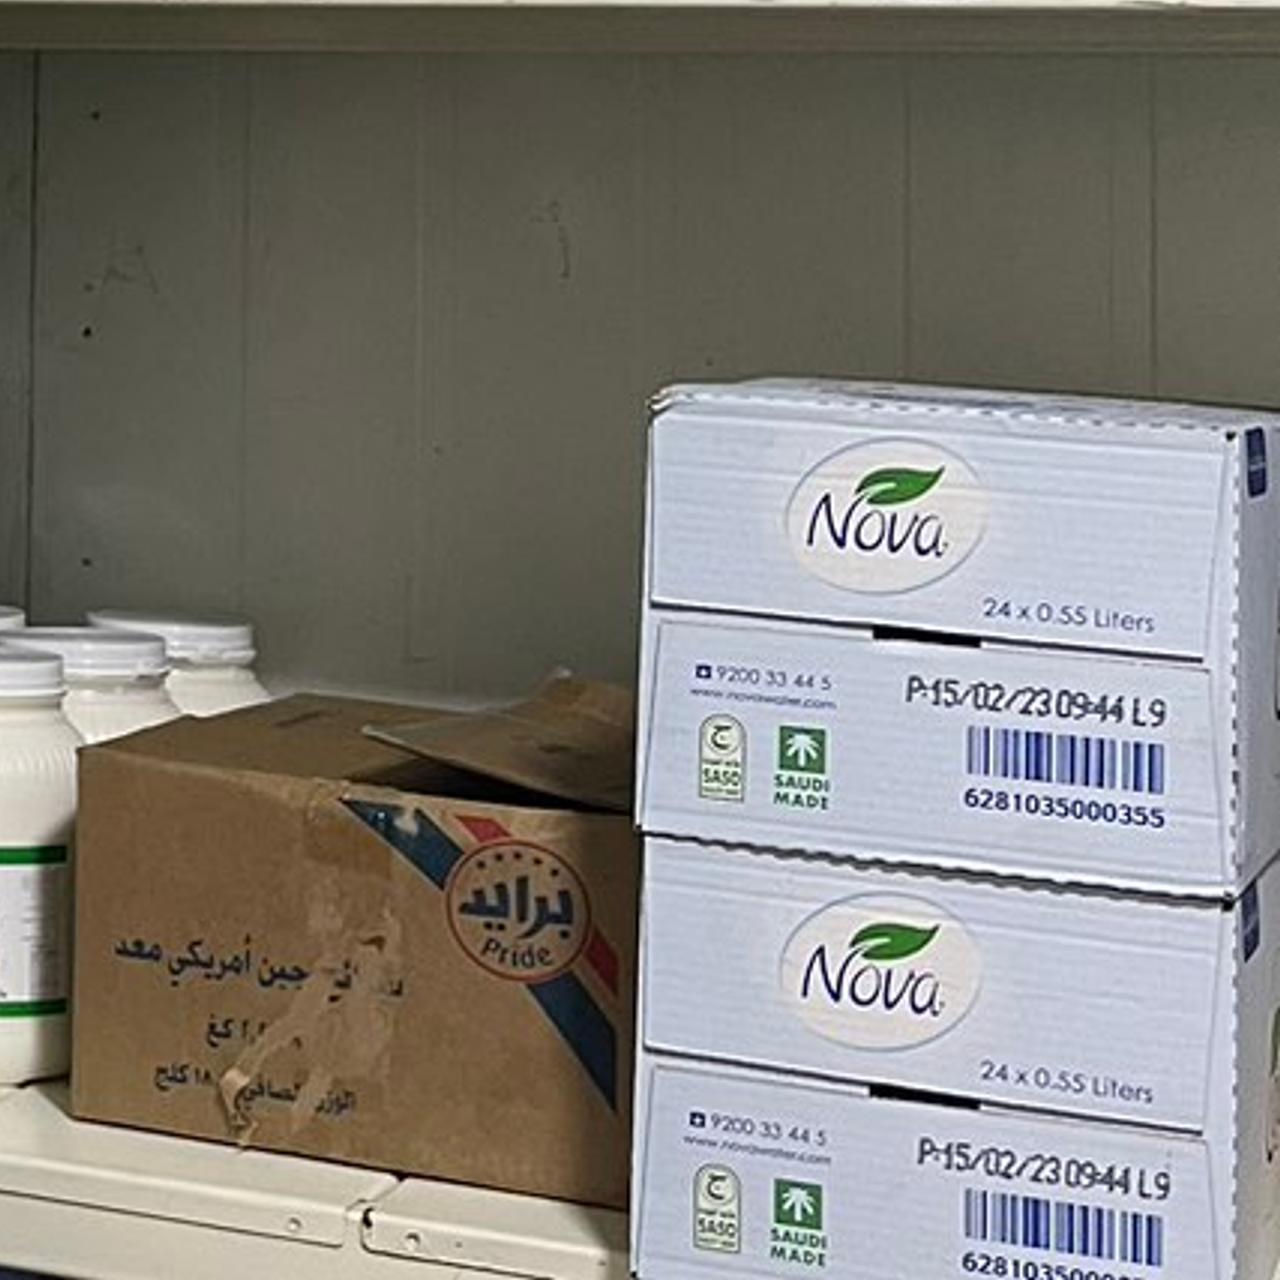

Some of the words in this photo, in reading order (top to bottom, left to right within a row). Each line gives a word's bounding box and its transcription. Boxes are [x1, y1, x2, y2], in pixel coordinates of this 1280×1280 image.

[806, 492, 944, 558] Nova
[983, 597, 1012, 619] 24
[1037, 602, 1087, 626] 0.55
[1094, 608, 1155, 633] Liters
[716, 665, 760, 685] 9200
[765, 670, 787, 687] 33
[794, 673, 814, 689] 44
[773, 773, 831, 793] SAUDI
[773, 791, 829, 811] MADE
[964, 787, 1166, 829] 6281035000355
[458, 875, 574, 940] برايد
[481, 938, 554, 969] Pride
[800, 943, 941, 1018] Nova
[979, 1059, 1008, 1082] 24
[1034, 1067, 1086, 1095] 0.55
[1092, 1076, 1153, 1104] Liters
[710, 1112, 755, 1135] 9200
[759, 1121, 782, 1141] 33
[788, 1126, 810, 1143] 44
[770, 1228, 828, 1249] SAUDI
[769, 1246, 826, 1268] MADE
